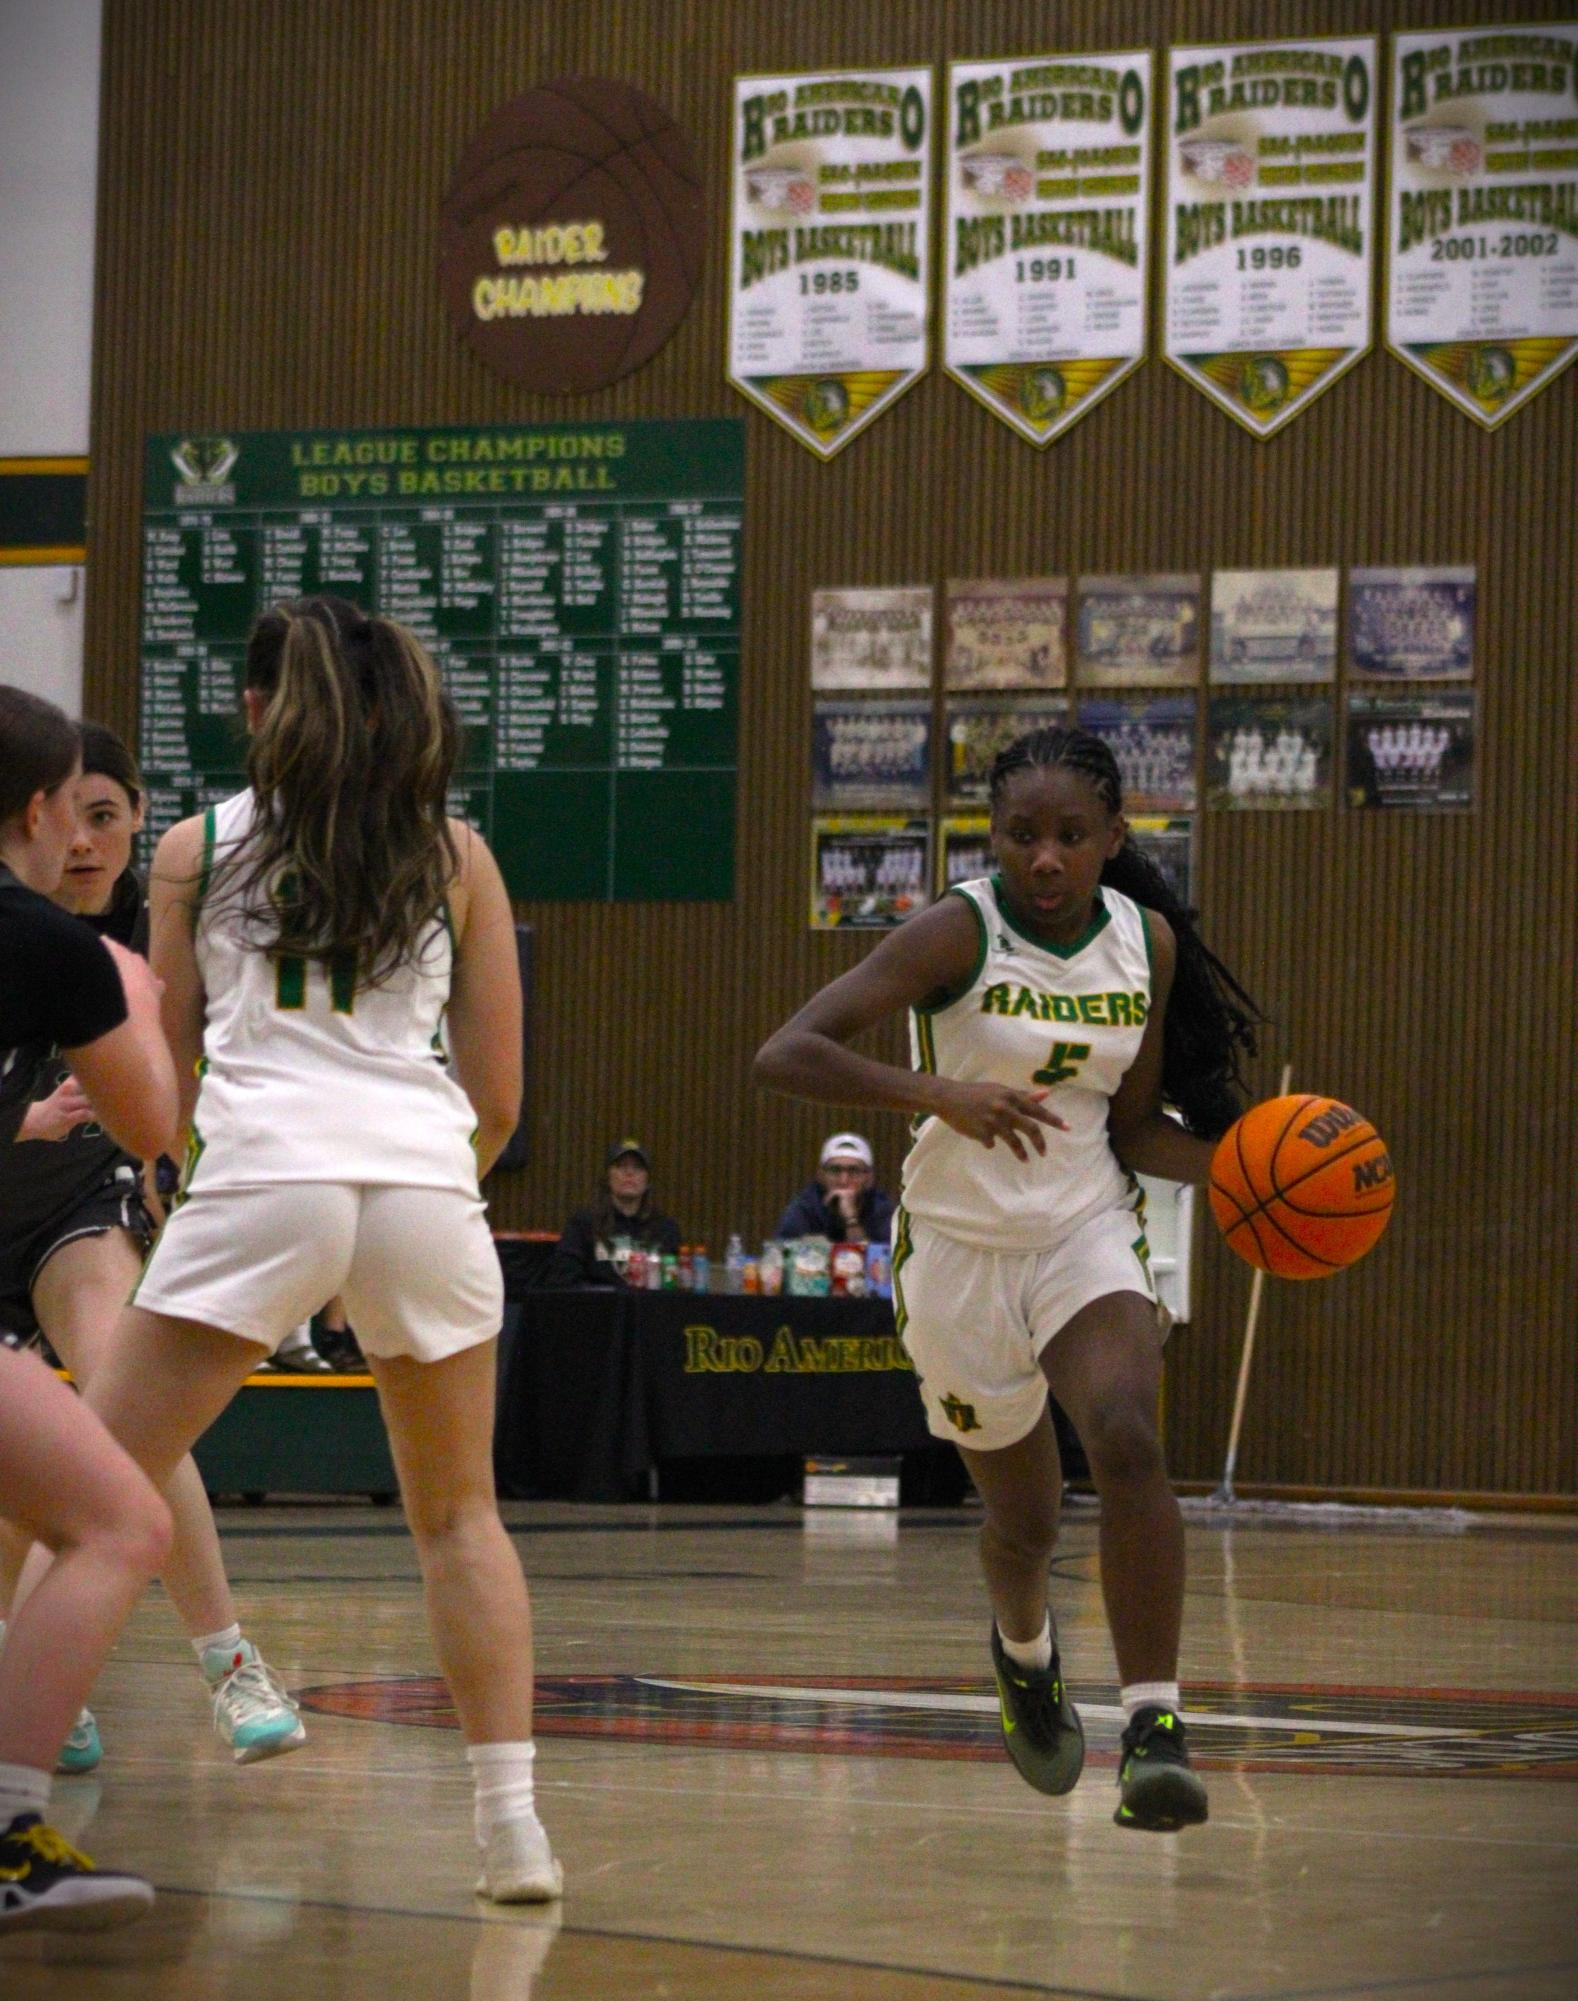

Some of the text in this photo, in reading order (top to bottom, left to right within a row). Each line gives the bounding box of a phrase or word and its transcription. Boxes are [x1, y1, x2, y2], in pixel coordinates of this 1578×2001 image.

[1208, 77, 1337, 114] RAIDERS
[1434, 62, 1567, 100] RAIDERS
[771, 106, 894, 142] RAIDERS
[988, 92, 1112, 129] RAIDERS
[494, 222, 608, 266] RAIDER
[1236, 245, 1302, 272] 1996
[1430, 233, 1559, 262] 2001-2002
[800, 271, 859, 296] 1985
[1015, 257, 1077, 283] 1991
[474, 270, 645, 321] CHAMPIONS
[292, 431, 625, 466] LEAGUE CHAMPIONS
[299, 464, 617, 497] BOYS BASKETBALL
[980, 981, 1150, 1026] RAIDERS
[1032, 1041, 1092, 1086] 5
